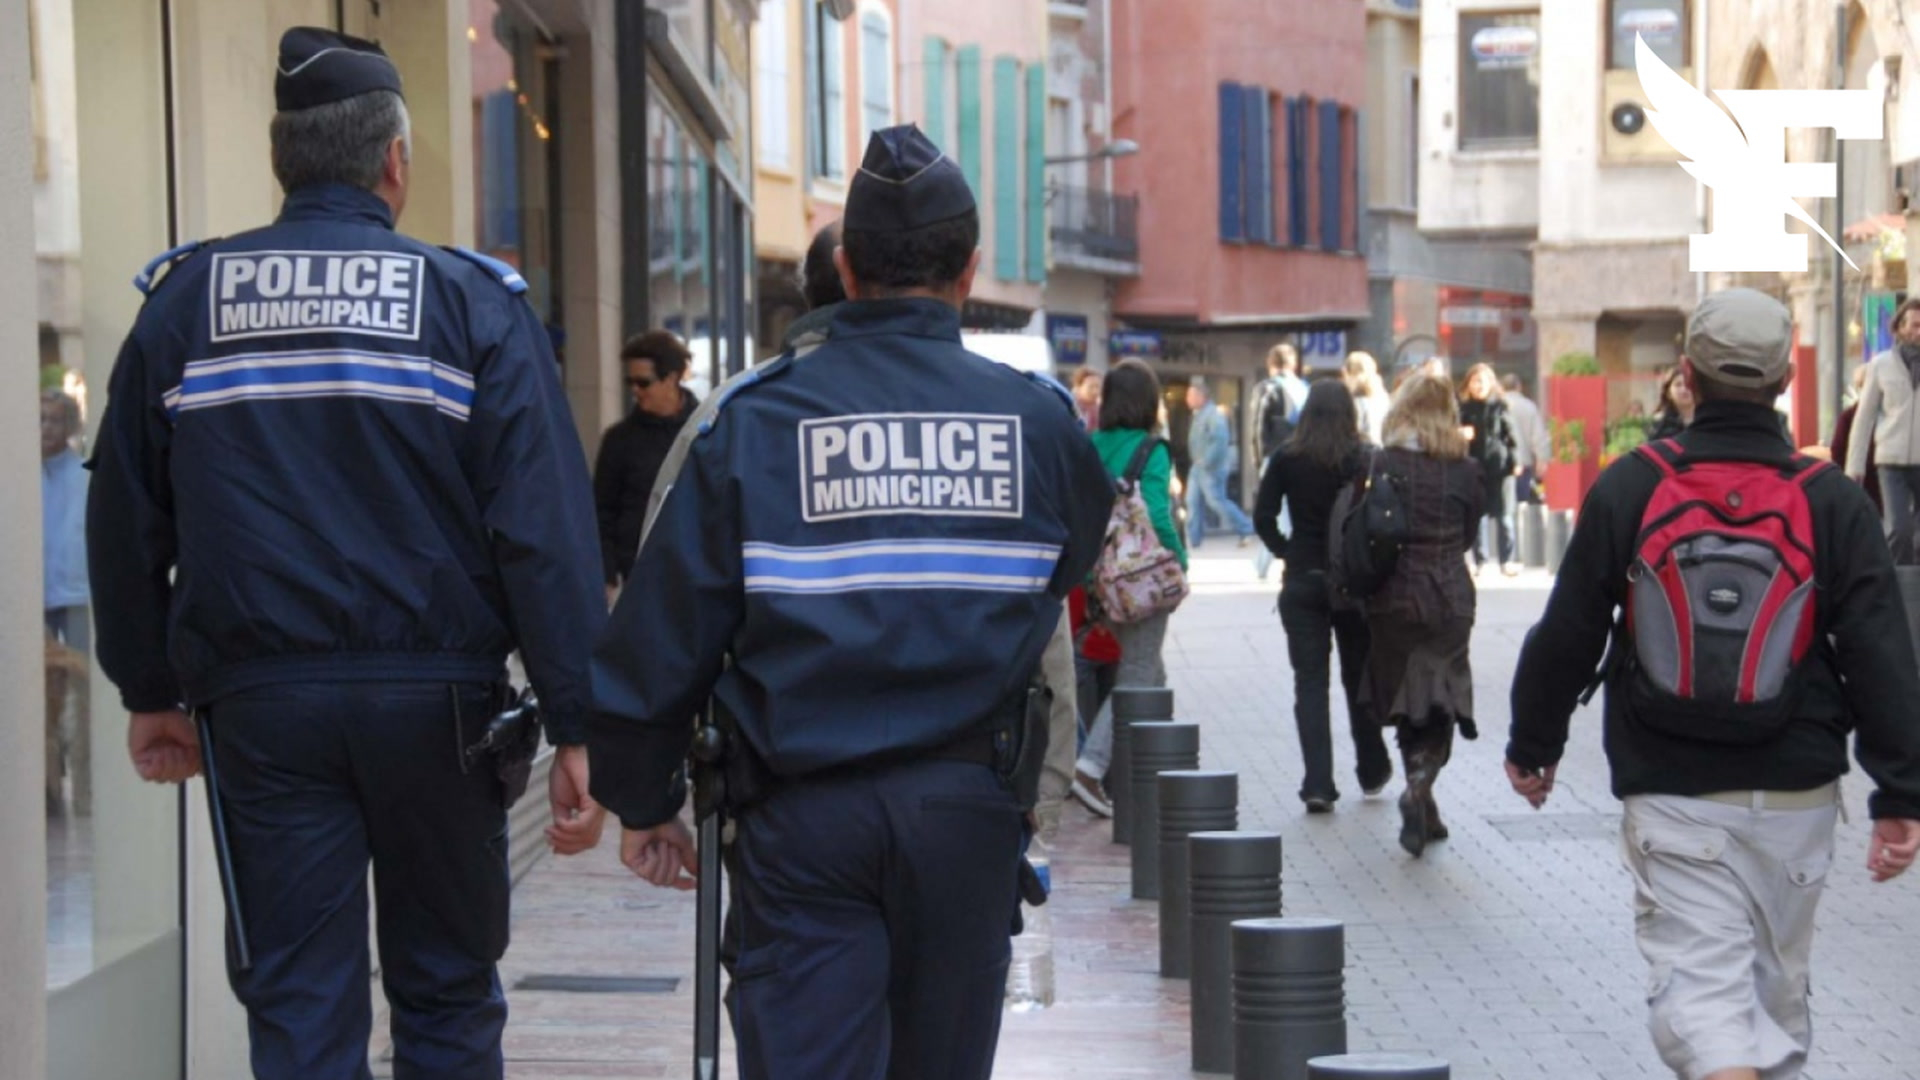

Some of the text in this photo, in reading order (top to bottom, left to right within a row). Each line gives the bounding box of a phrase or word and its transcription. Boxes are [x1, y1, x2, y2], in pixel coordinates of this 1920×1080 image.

[220, 255, 412, 299] POLICE
[220, 299, 409, 333] MUNICIPALE
[810, 421, 1012, 476] POLICE
[812, 474, 1012, 512] MUNICIPALE
